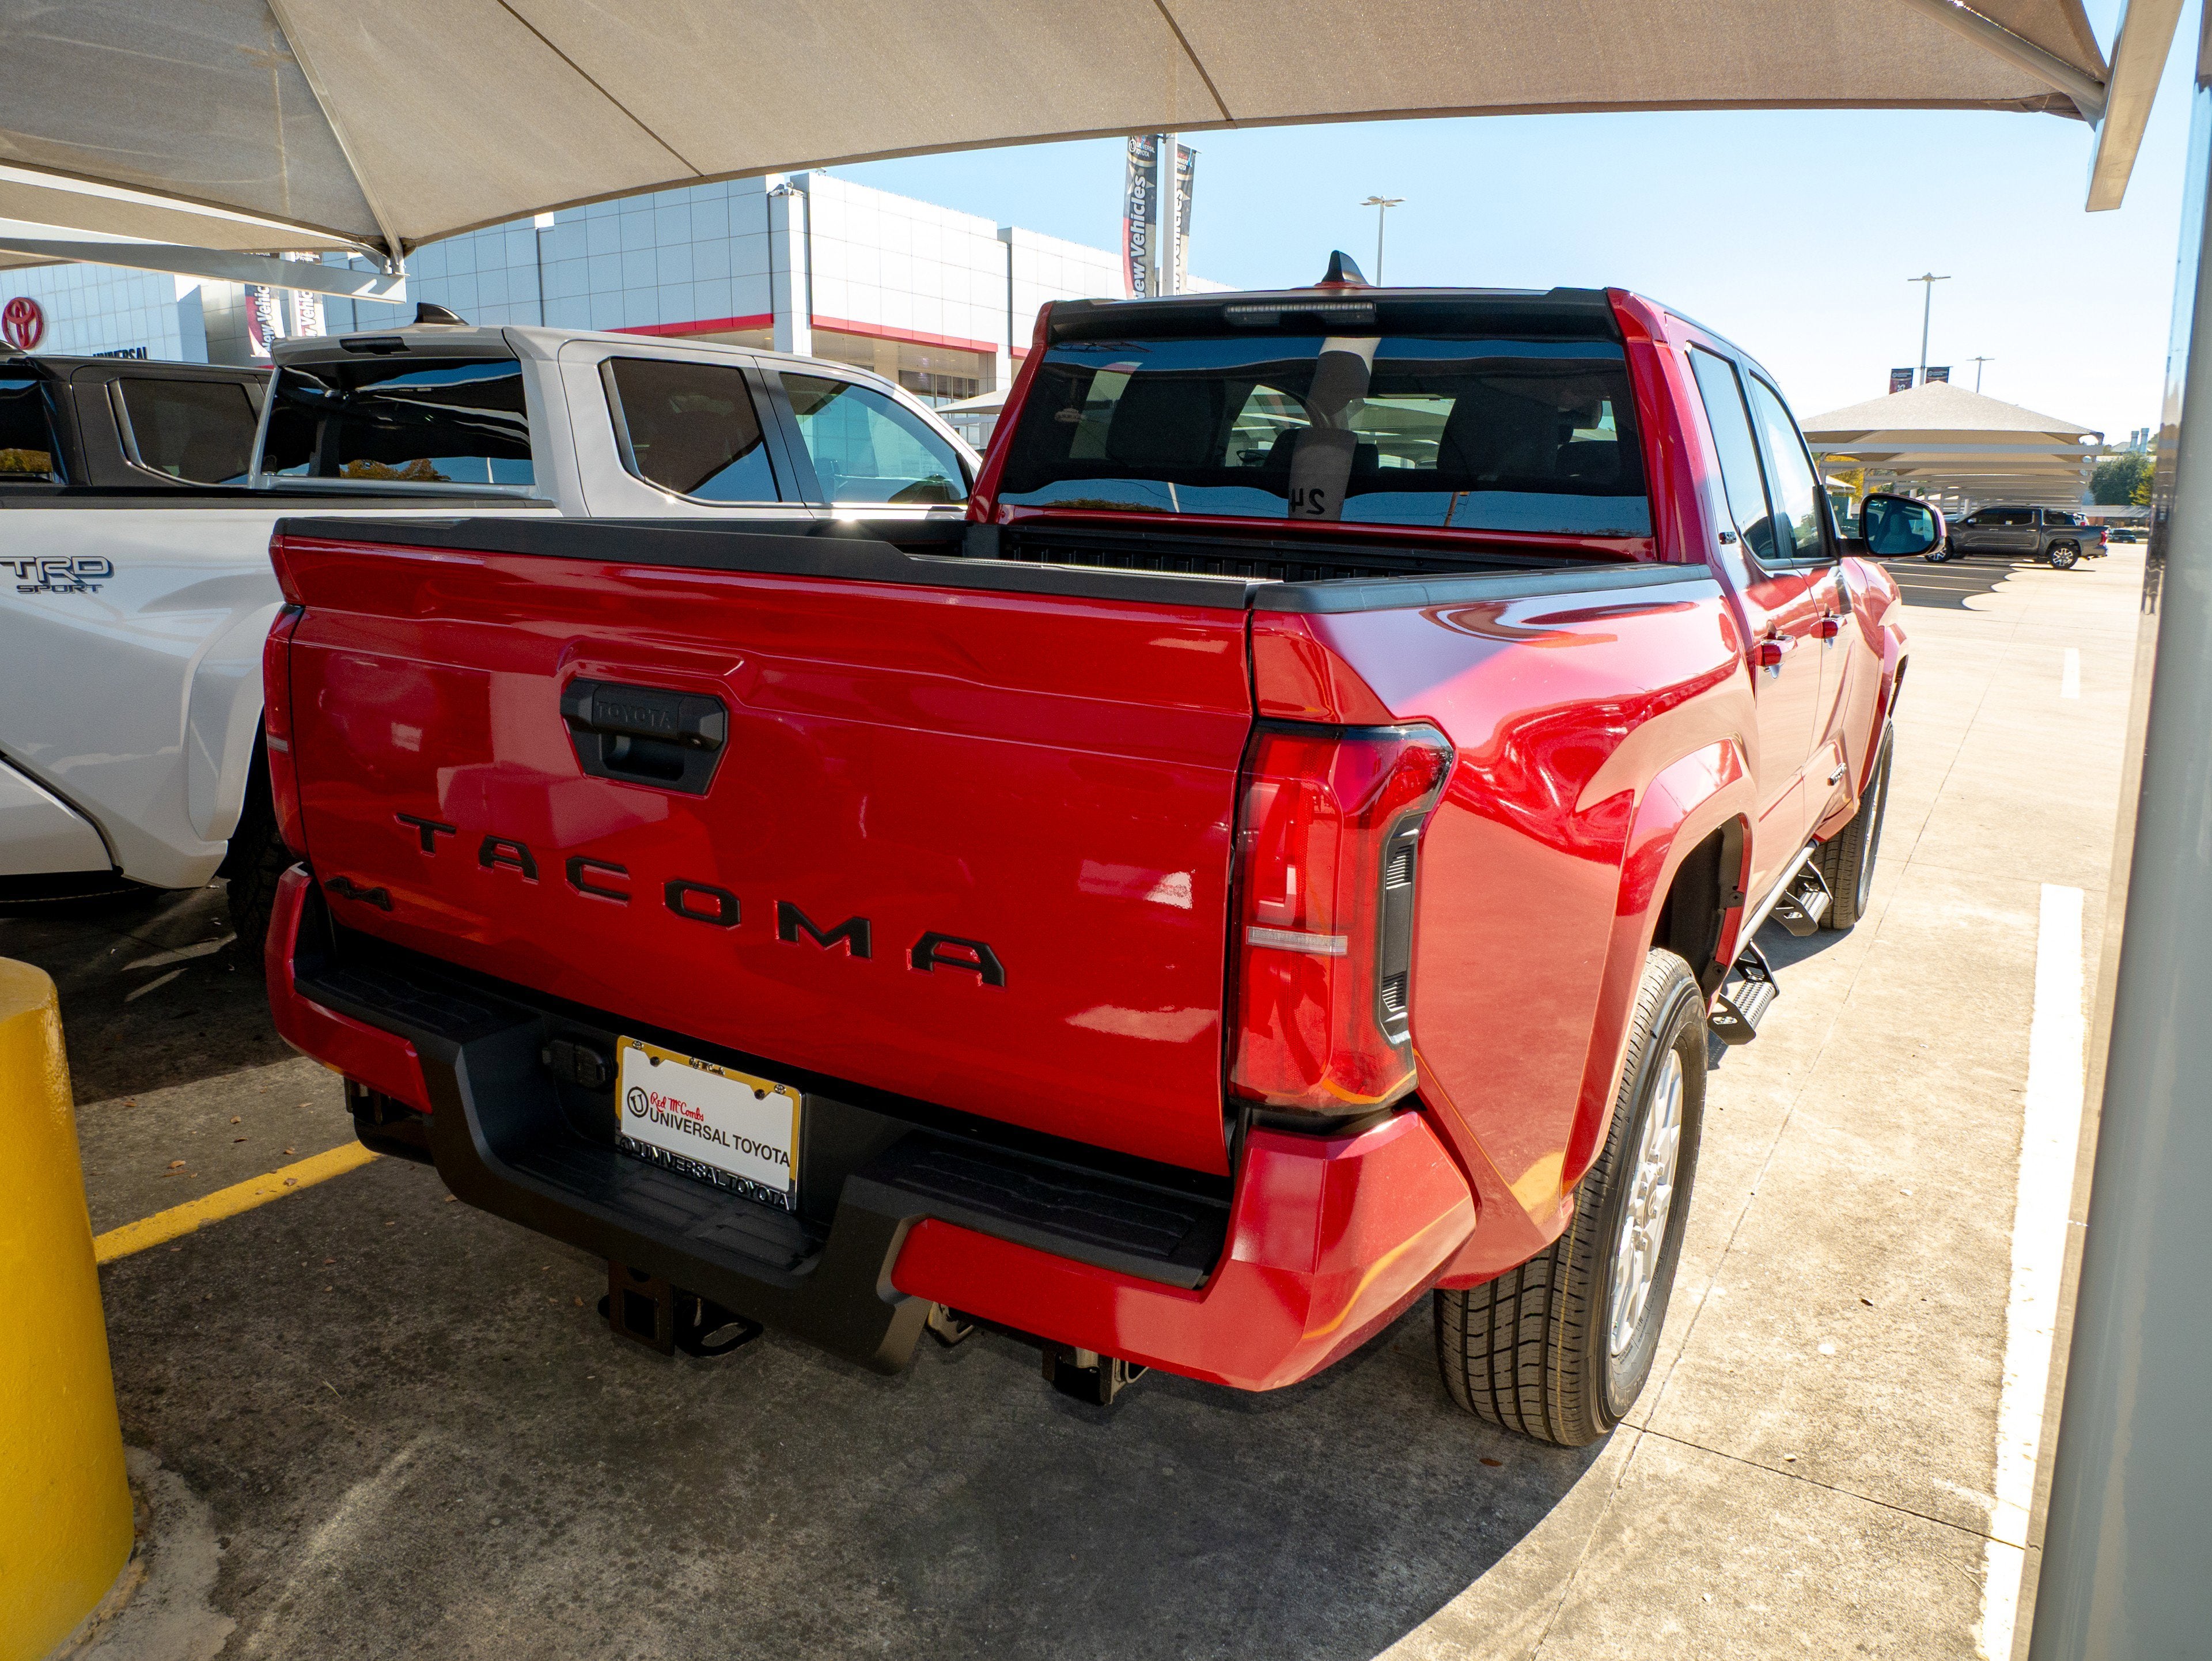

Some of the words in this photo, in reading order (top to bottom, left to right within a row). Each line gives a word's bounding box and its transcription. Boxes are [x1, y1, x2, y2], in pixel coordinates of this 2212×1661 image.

[1130, 175, 1146, 258] Vehicles
[0, 556, 115, 585] TRD
[16, 584, 104, 595] SPORT
[597, 701, 671, 729] TOYOTA
[395, 812, 1005, 987] TACOMA
[650, 1092, 667, 1113] Red
[668, 1097, 704, 1122] McCombs
[650, 1107, 730, 1147] UNIVERSAL
[732, 1134, 790, 1167] TOYOTA
[640, 1142, 726, 1186] UNIVERSAL
[727, 1173, 790, 1210] TOYOTA
